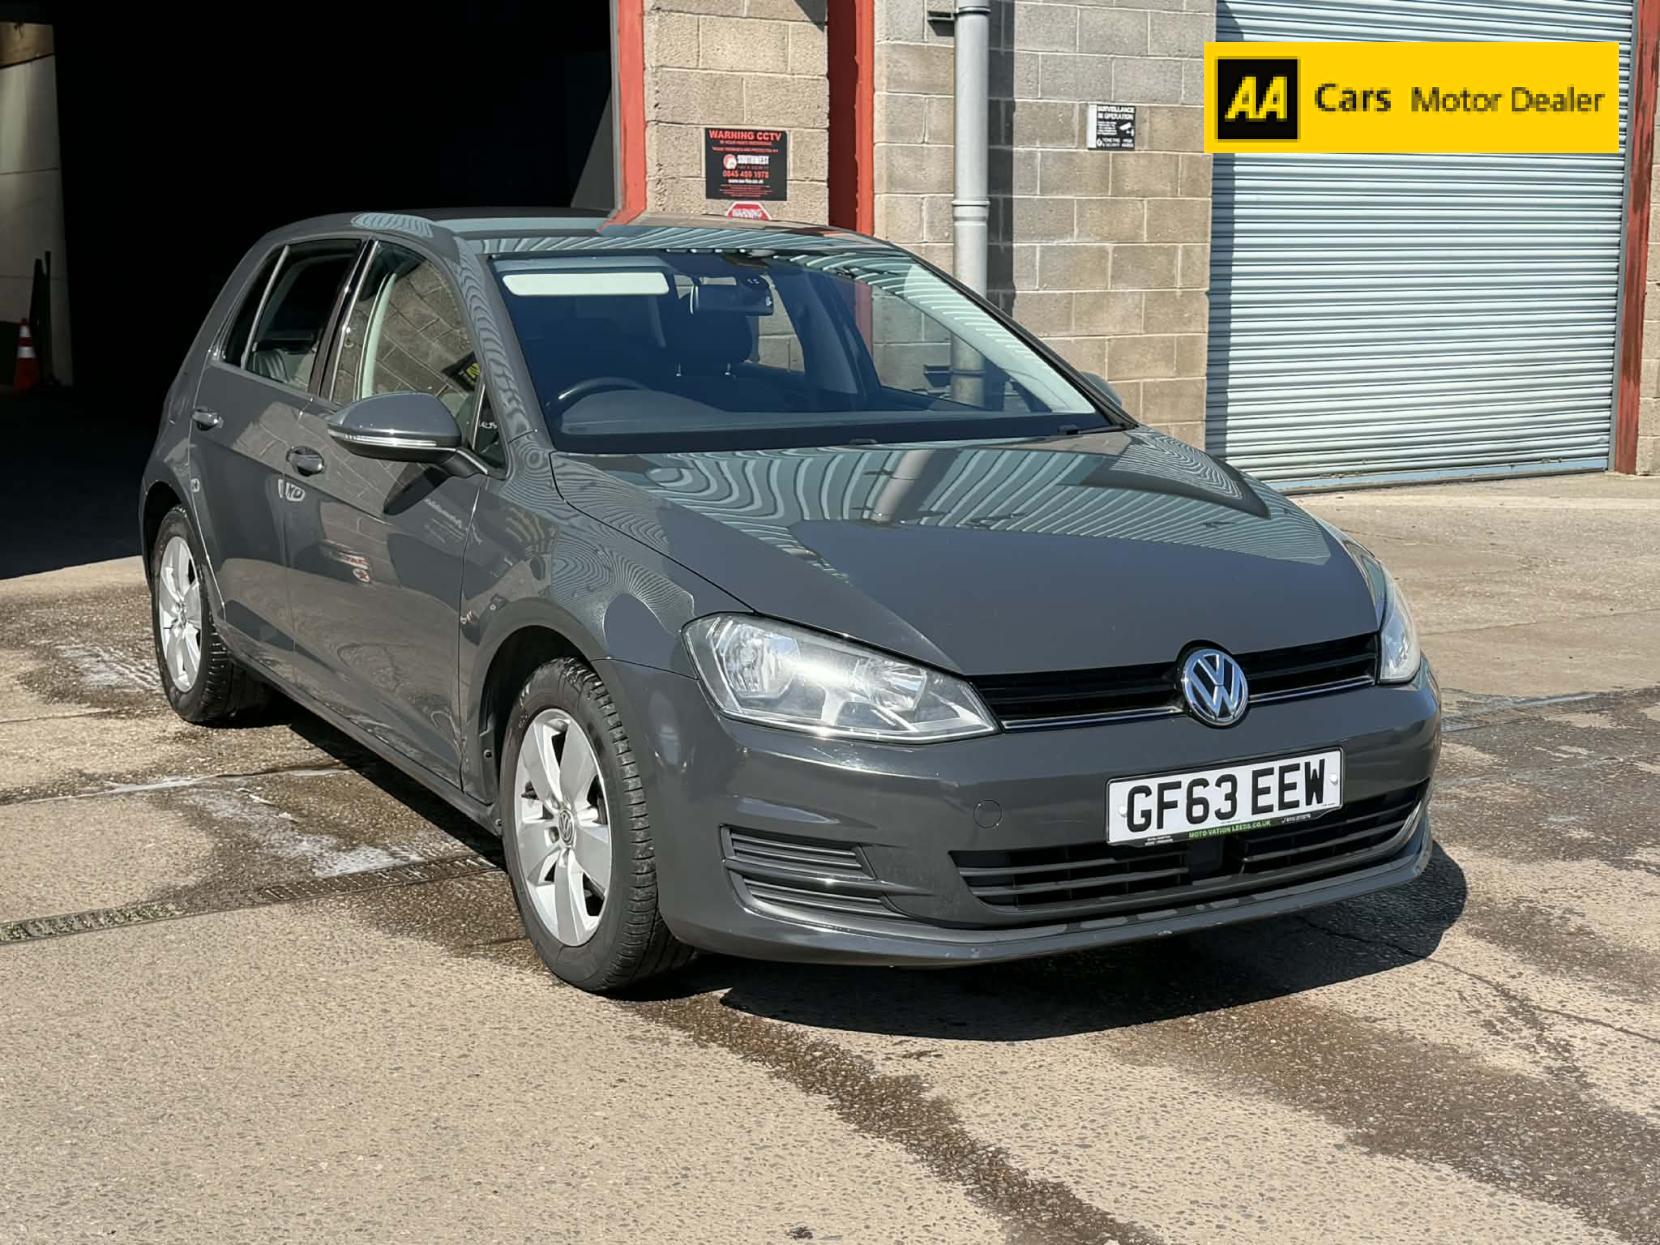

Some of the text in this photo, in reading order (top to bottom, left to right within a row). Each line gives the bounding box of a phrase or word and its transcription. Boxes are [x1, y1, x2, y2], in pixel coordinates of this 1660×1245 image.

[709, 129, 781, 141] WARNING CCTV
[1126, 758, 1325, 832] GF63 EEW
